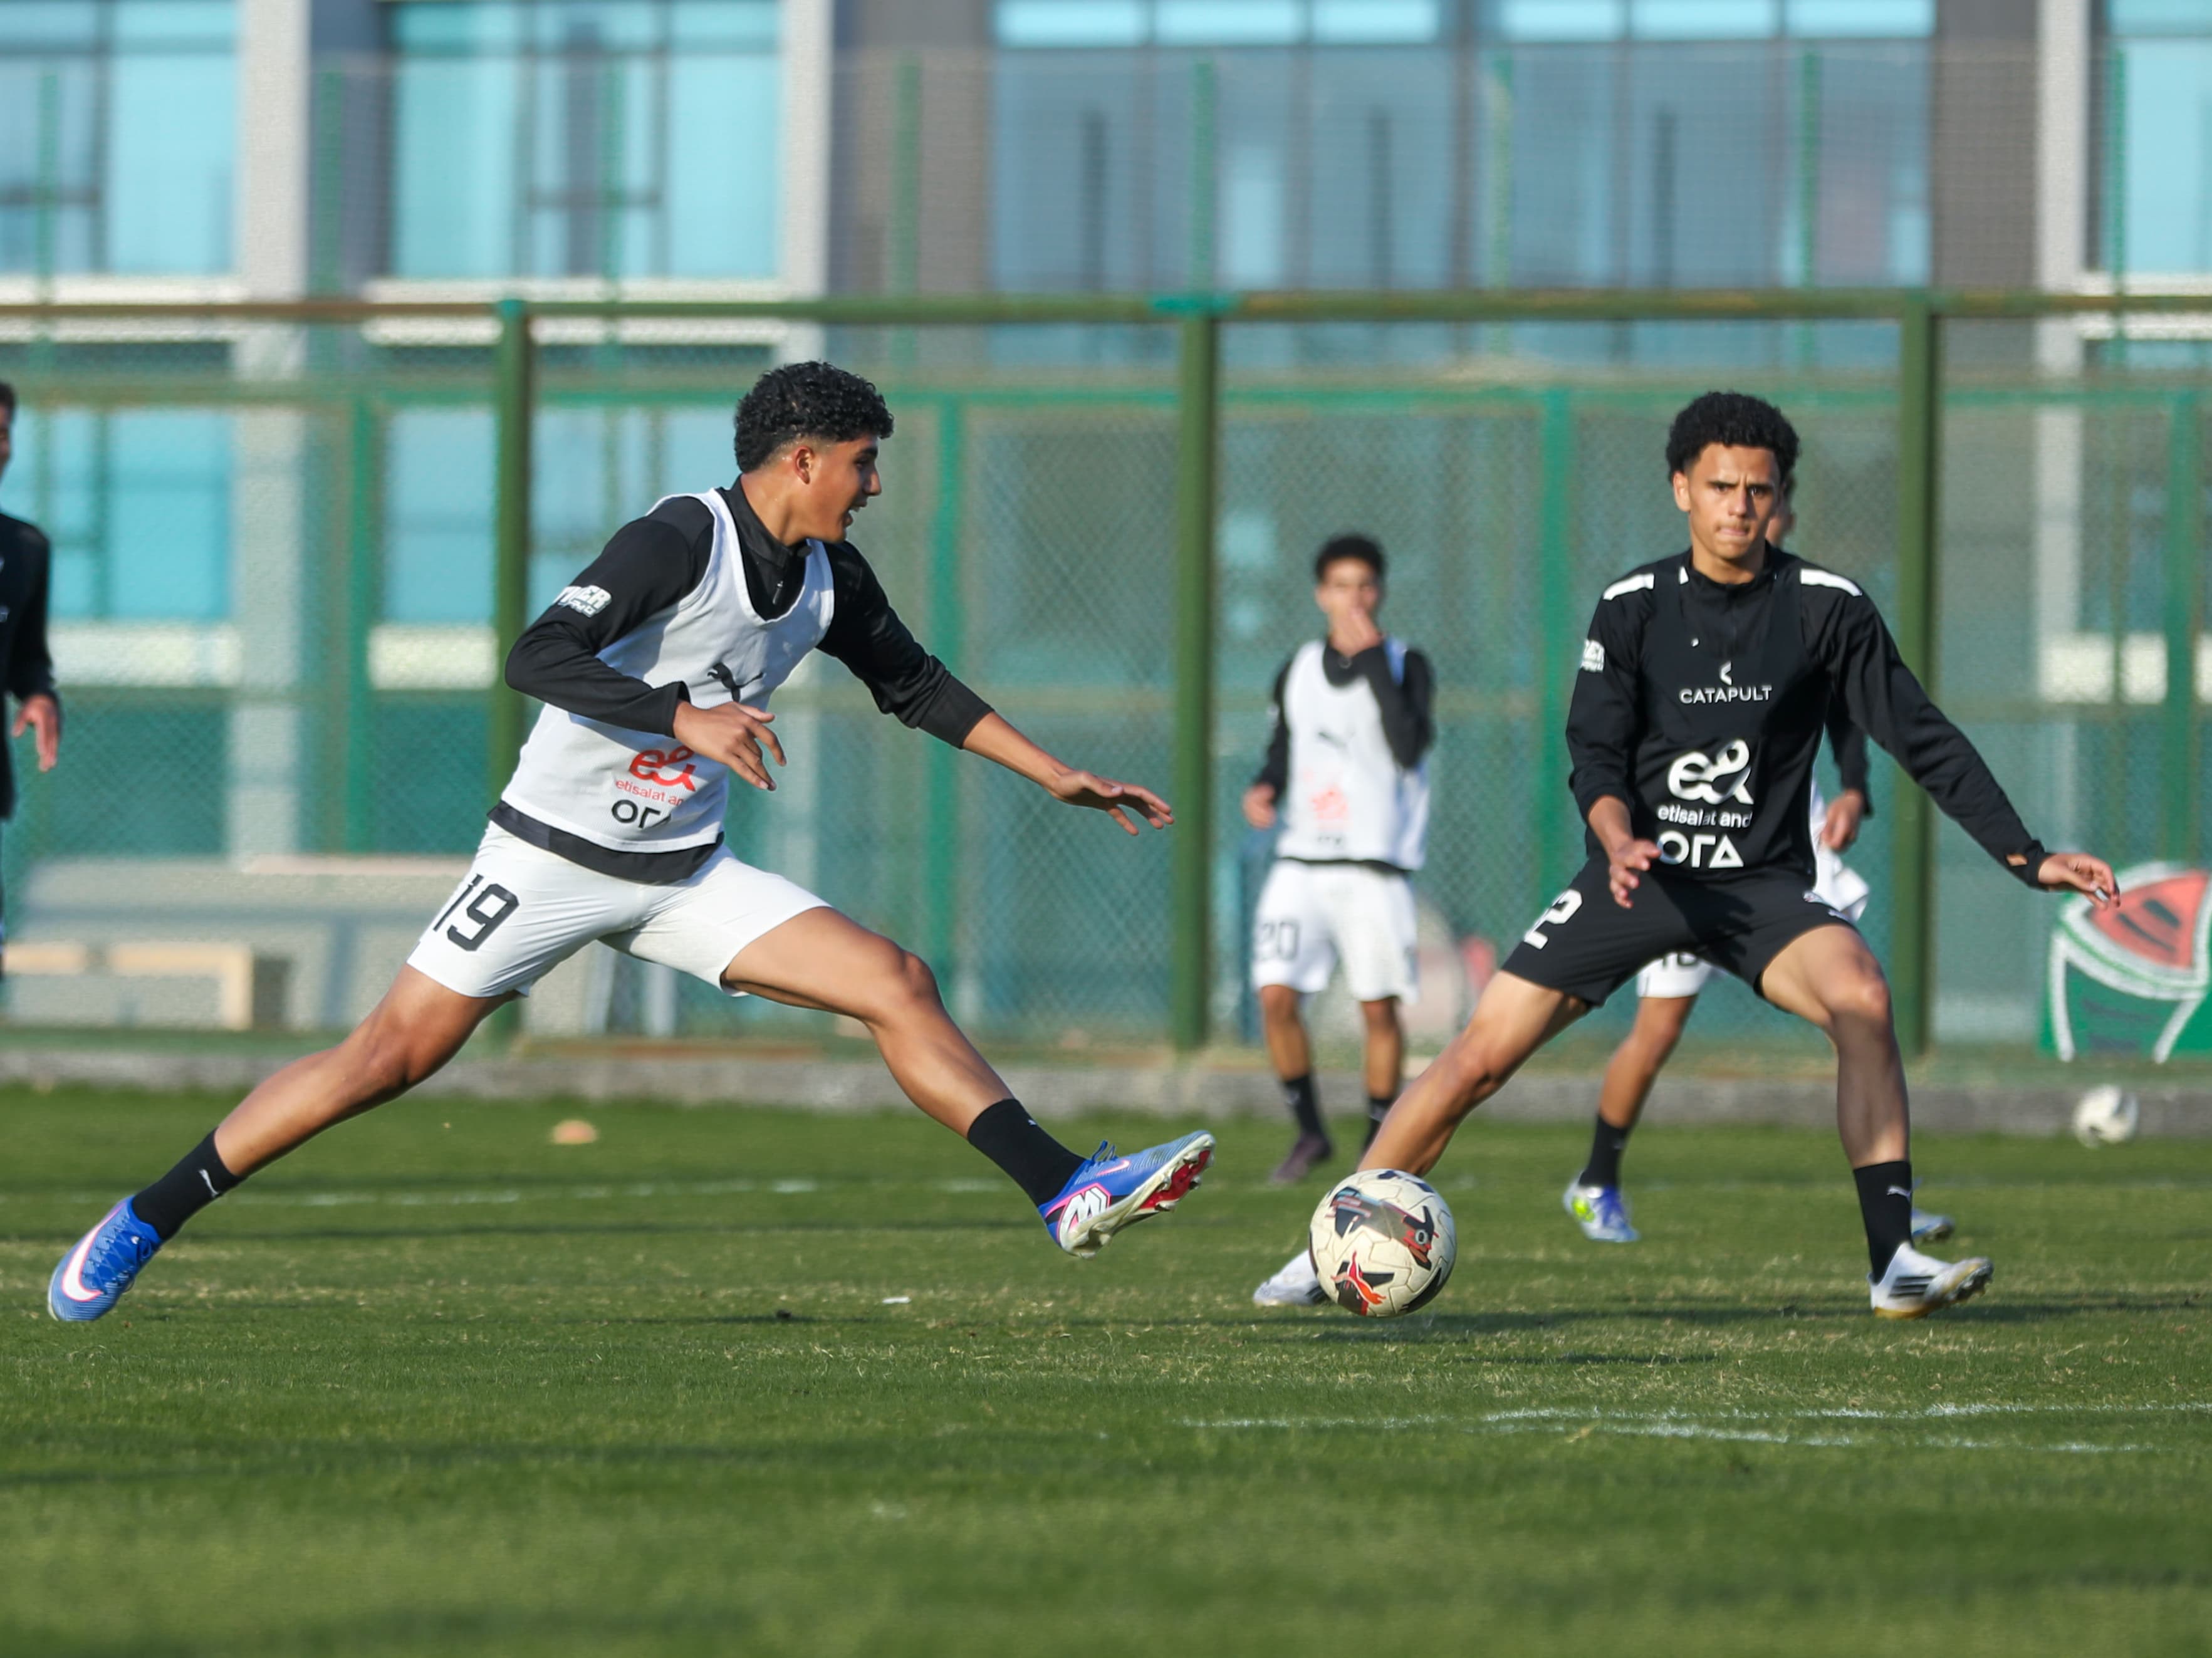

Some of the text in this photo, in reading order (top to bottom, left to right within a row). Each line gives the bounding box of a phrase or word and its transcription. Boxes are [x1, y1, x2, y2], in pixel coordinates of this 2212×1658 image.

[1679, 685, 1772, 704] CATAPULT
[615, 779, 666, 801] etisalat
[1657, 804, 1717, 826] etisalat
[433, 873, 520, 952] 19
